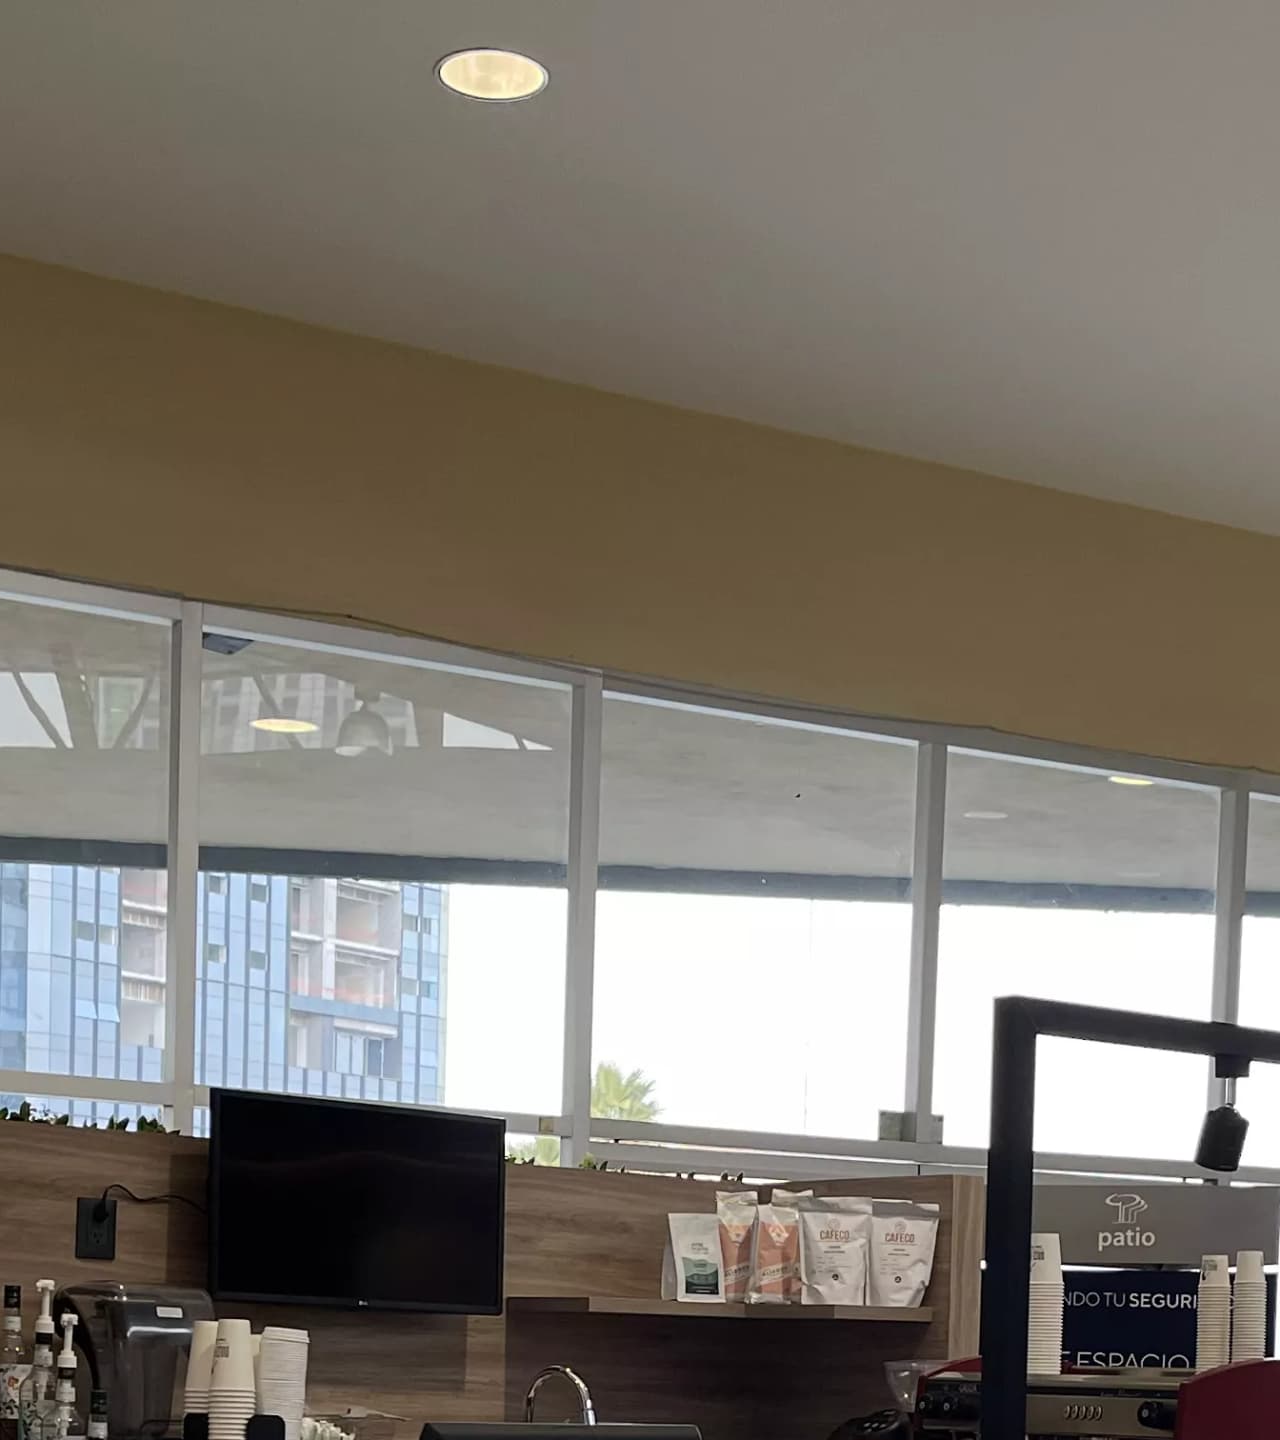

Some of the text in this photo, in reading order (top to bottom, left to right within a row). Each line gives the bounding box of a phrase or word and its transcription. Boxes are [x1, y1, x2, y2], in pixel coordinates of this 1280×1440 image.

[820, 1230, 850, 1241] CAFECO
[1098, 1227, 1156, 1252] patio
[1104, 1293, 1126, 1307] TU
[1077, 1351, 1190, 1368] ESPACIO
